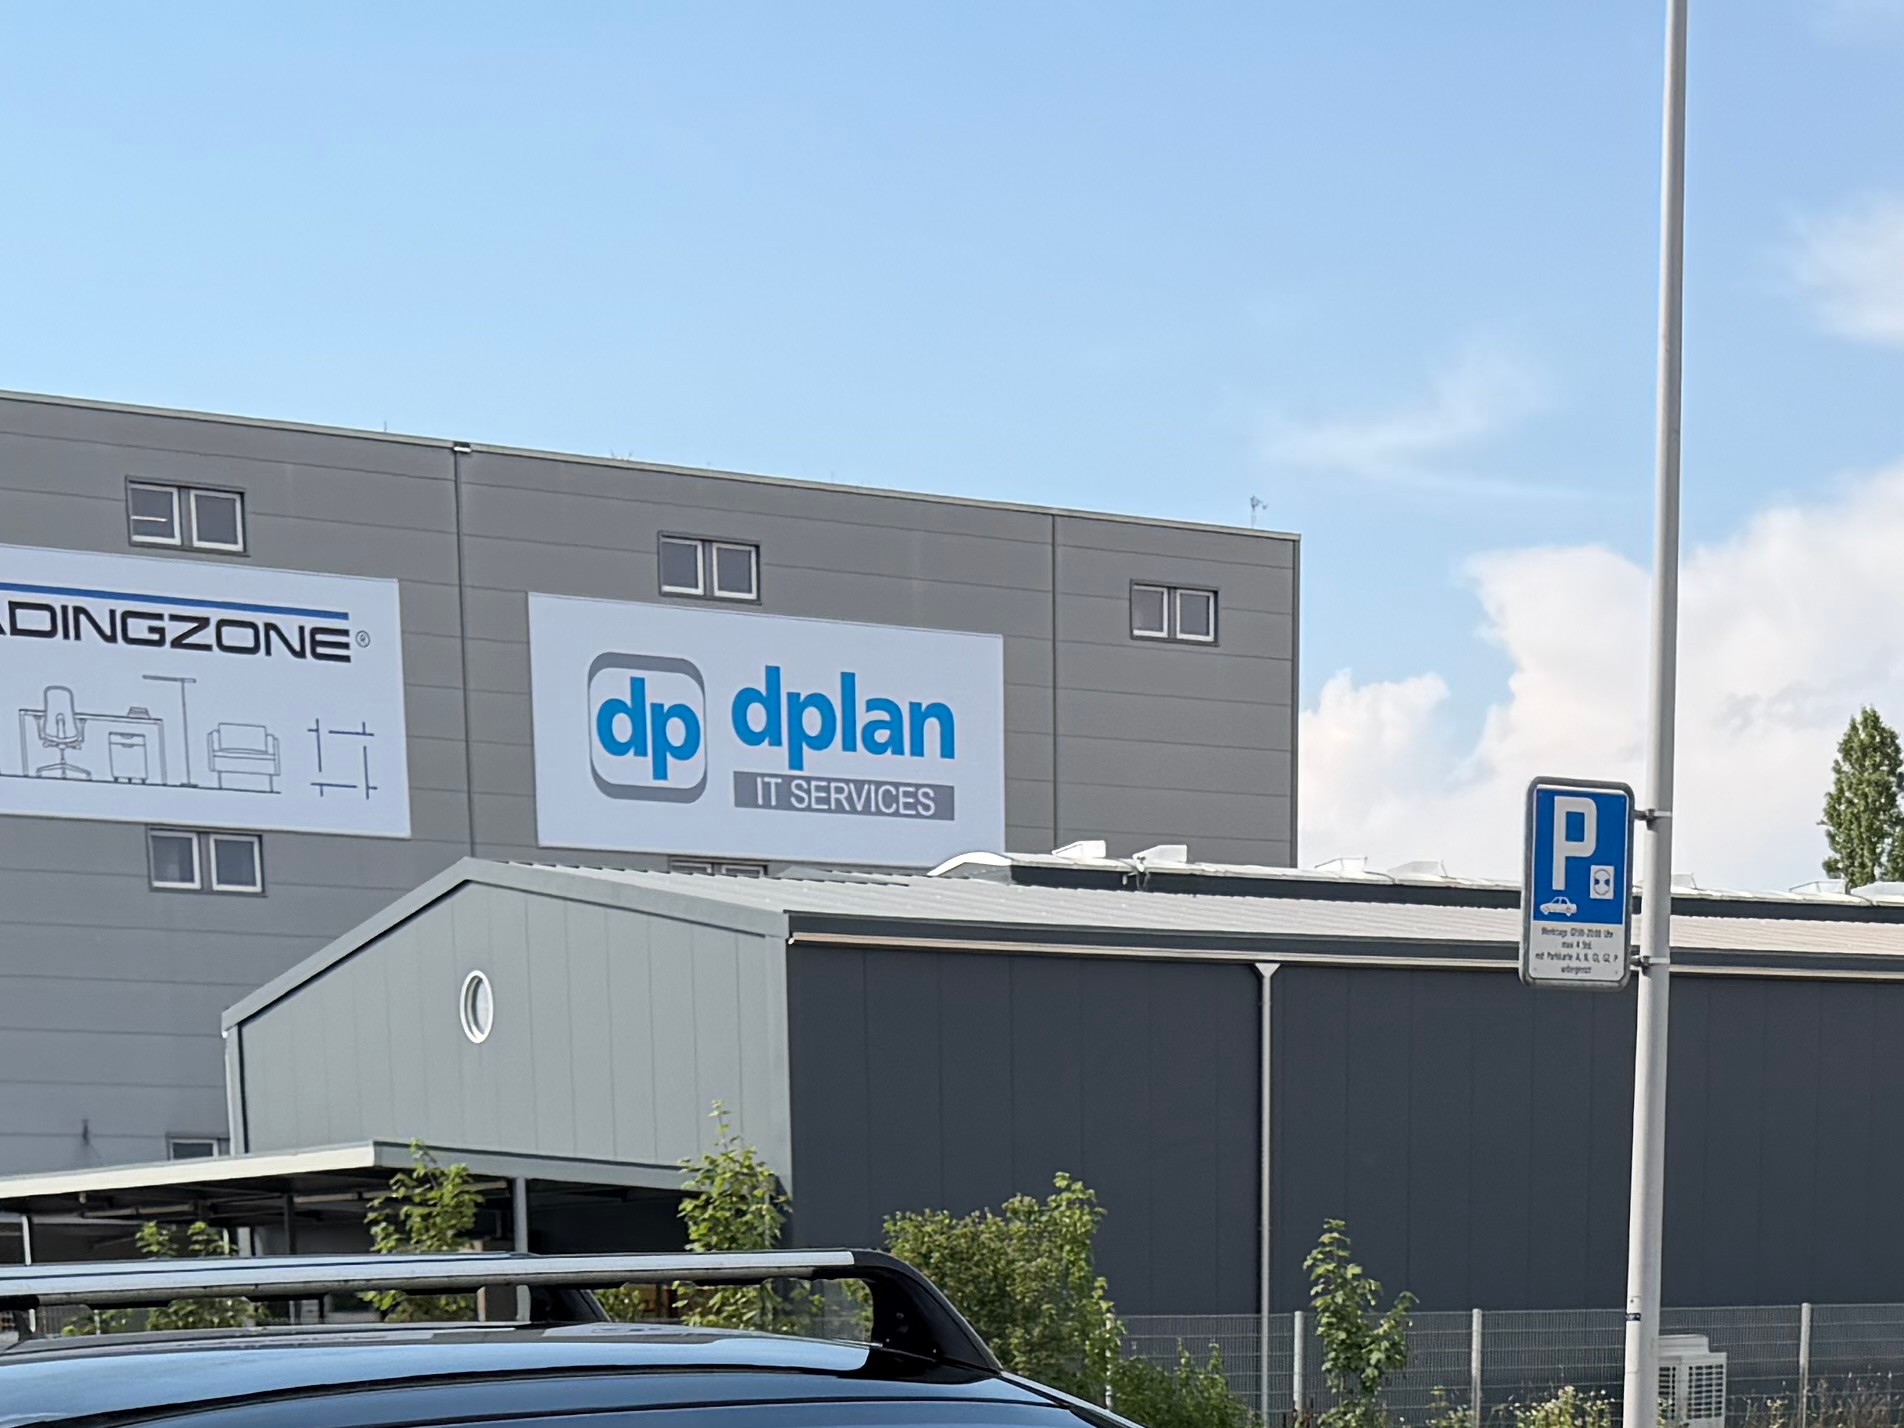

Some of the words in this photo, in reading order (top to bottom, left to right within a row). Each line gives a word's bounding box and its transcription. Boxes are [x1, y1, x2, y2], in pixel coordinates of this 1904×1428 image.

[596, 675, 702, 780] dp
[730, 664, 956, 771] dplan
[756, 776, 782, 806] IT
[790, 779, 936, 817] SERVICES
[1552, 796, 1597, 890] P
